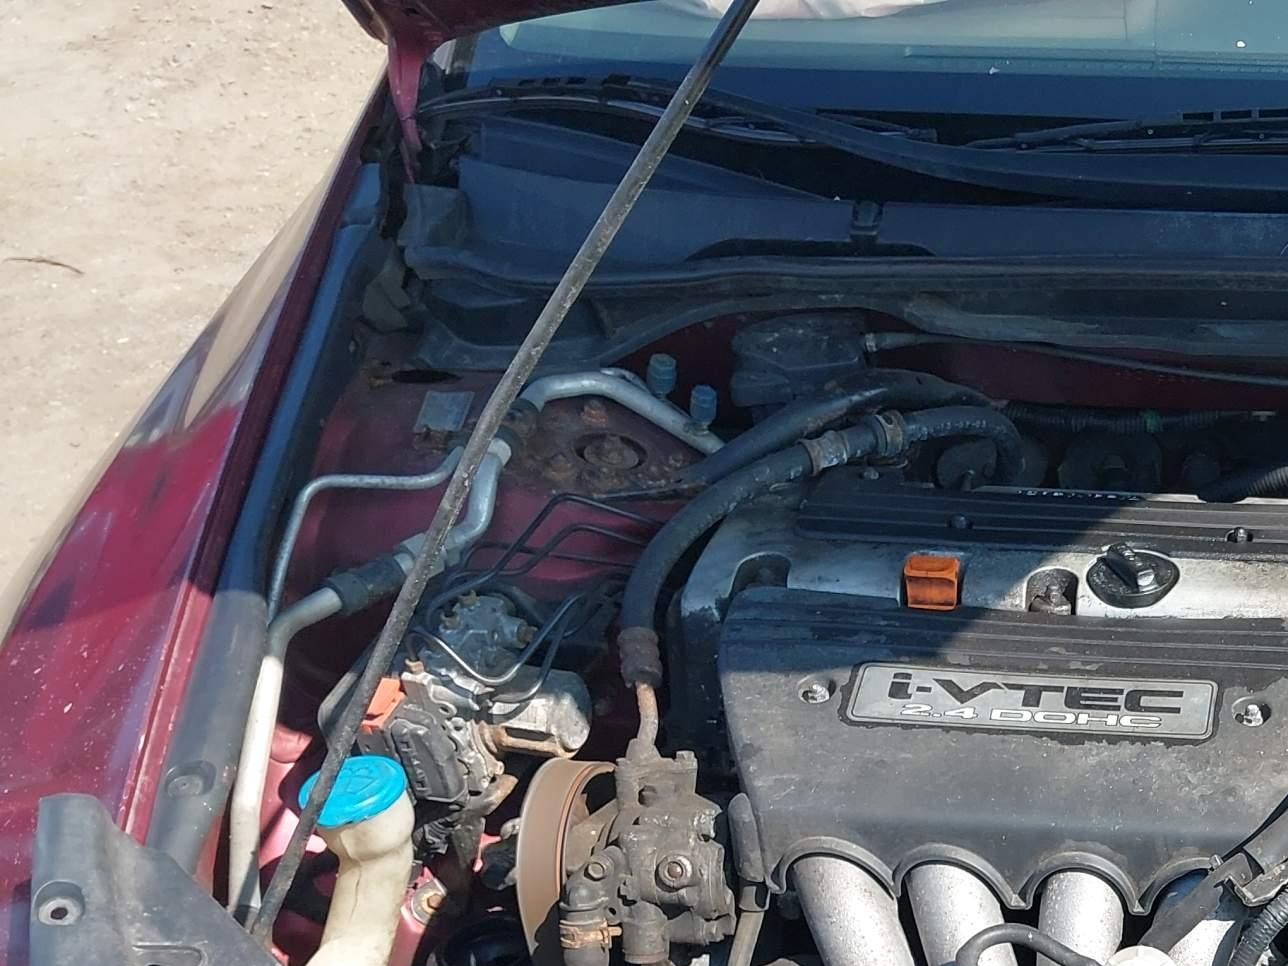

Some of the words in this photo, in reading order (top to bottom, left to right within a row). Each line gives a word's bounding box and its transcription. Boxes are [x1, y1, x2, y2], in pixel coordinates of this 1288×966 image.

[888, 672, 1185, 714] i-VTEC
[901, 703, 978, 719] 2.4
[989, 708, 1162, 728] DOHC
